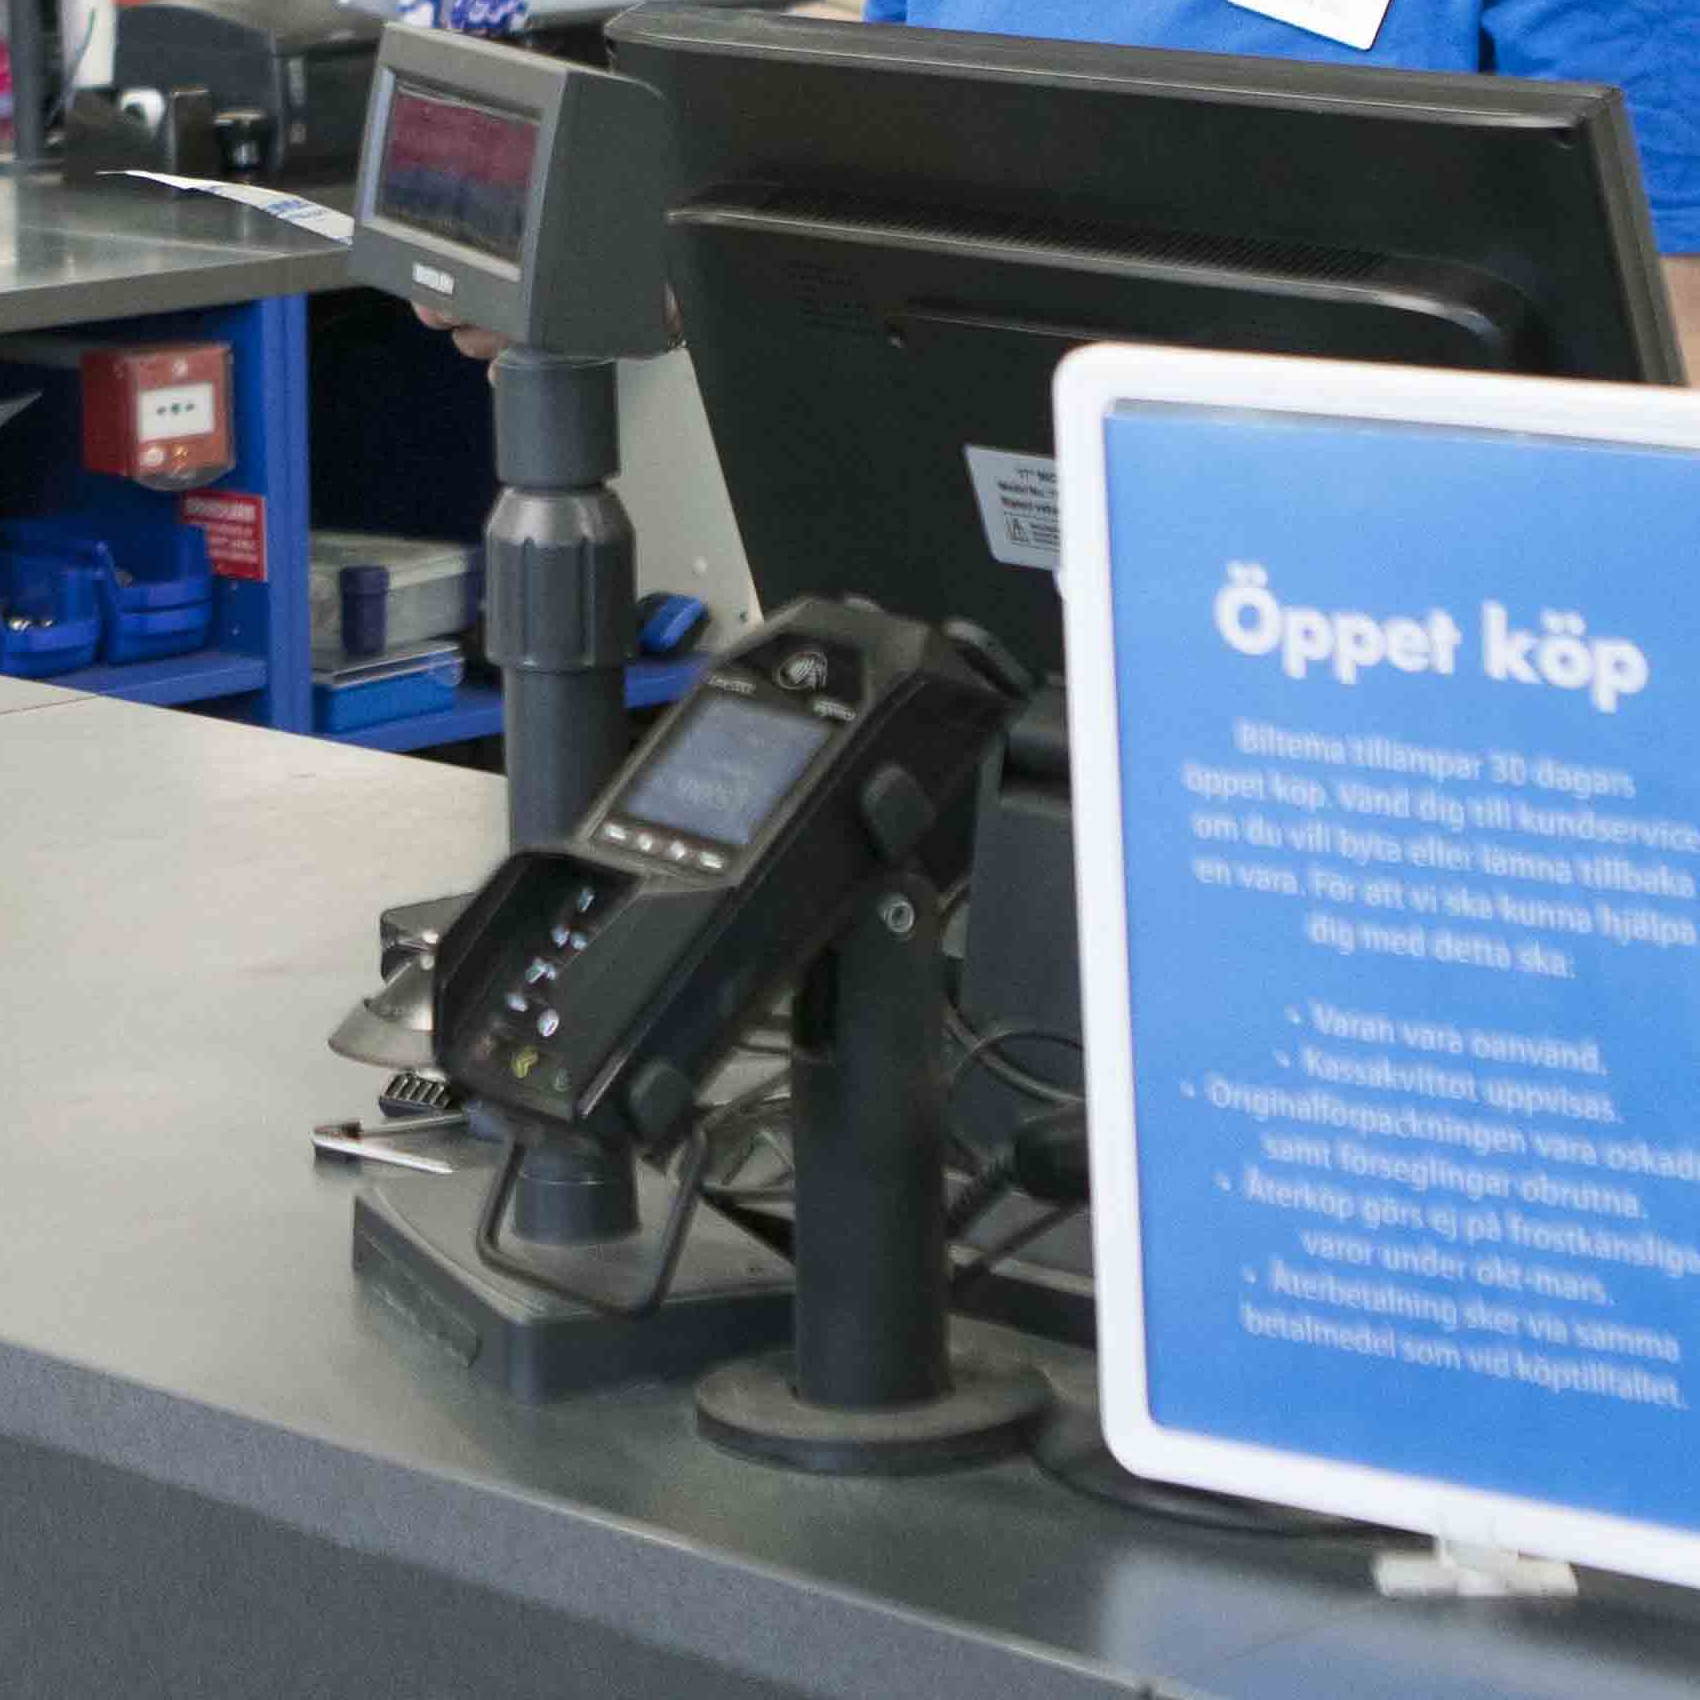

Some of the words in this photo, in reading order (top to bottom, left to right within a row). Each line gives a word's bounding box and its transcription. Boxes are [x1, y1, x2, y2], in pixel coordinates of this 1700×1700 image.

[1214, 562, 1462, 686] Öppet
[1481, 599, 1650, 713] köp
[1238, 722, 1347, 764] Biltema
[1493, 755, 1526, 787] 30
[1535, 760, 1636, 799] dagars
[1419, 791, 1465, 832] dig
[1474, 798, 1512, 830] till
[1518, 804, 1700, 853] kundservice
[1194, 815, 1239, 842] om
[1248, 816, 1283, 848] du
[1291, 822, 1331, 852] vill
[1340, 828, 1403, 866] byta
[1412, 836, 1473, 871] eller
[1579, 855, 1696, 899] tillbaka
[1196, 860, 1233, 887] en
[1366, 877, 1405, 910] att
[1412, 884, 1437, 913] vi
[1446, 888, 1494, 920] ska
[1500, 893, 1594, 933] kunna
[1309, 914, 1355, 956] dig
[1364, 923, 1427, 957] med
[1436, 933, 1512, 971] detta
[1311, 1002, 1397, 1043] Varan
[1405, 1022, 1465, 1053] vara
[1263, 1136, 1333, 1169] samt
[1537, 1135, 1598, 1167] vara
[1302, 1231, 1375, 1267] varor
[1384, 1243, 1468, 1281] under
[1468, 1211, 1503, 1246] på
[1243, 1303, 1397, 1359] betalmedel
[1405, 1339, 1462, 1371] som
[1469, 1346, 1511, 1380] vid
[1466, 1300, 1519, 1335] sker
[1528, 1312, 1569, 1343] via
[1575, 1325, 1680, 1363] samma
